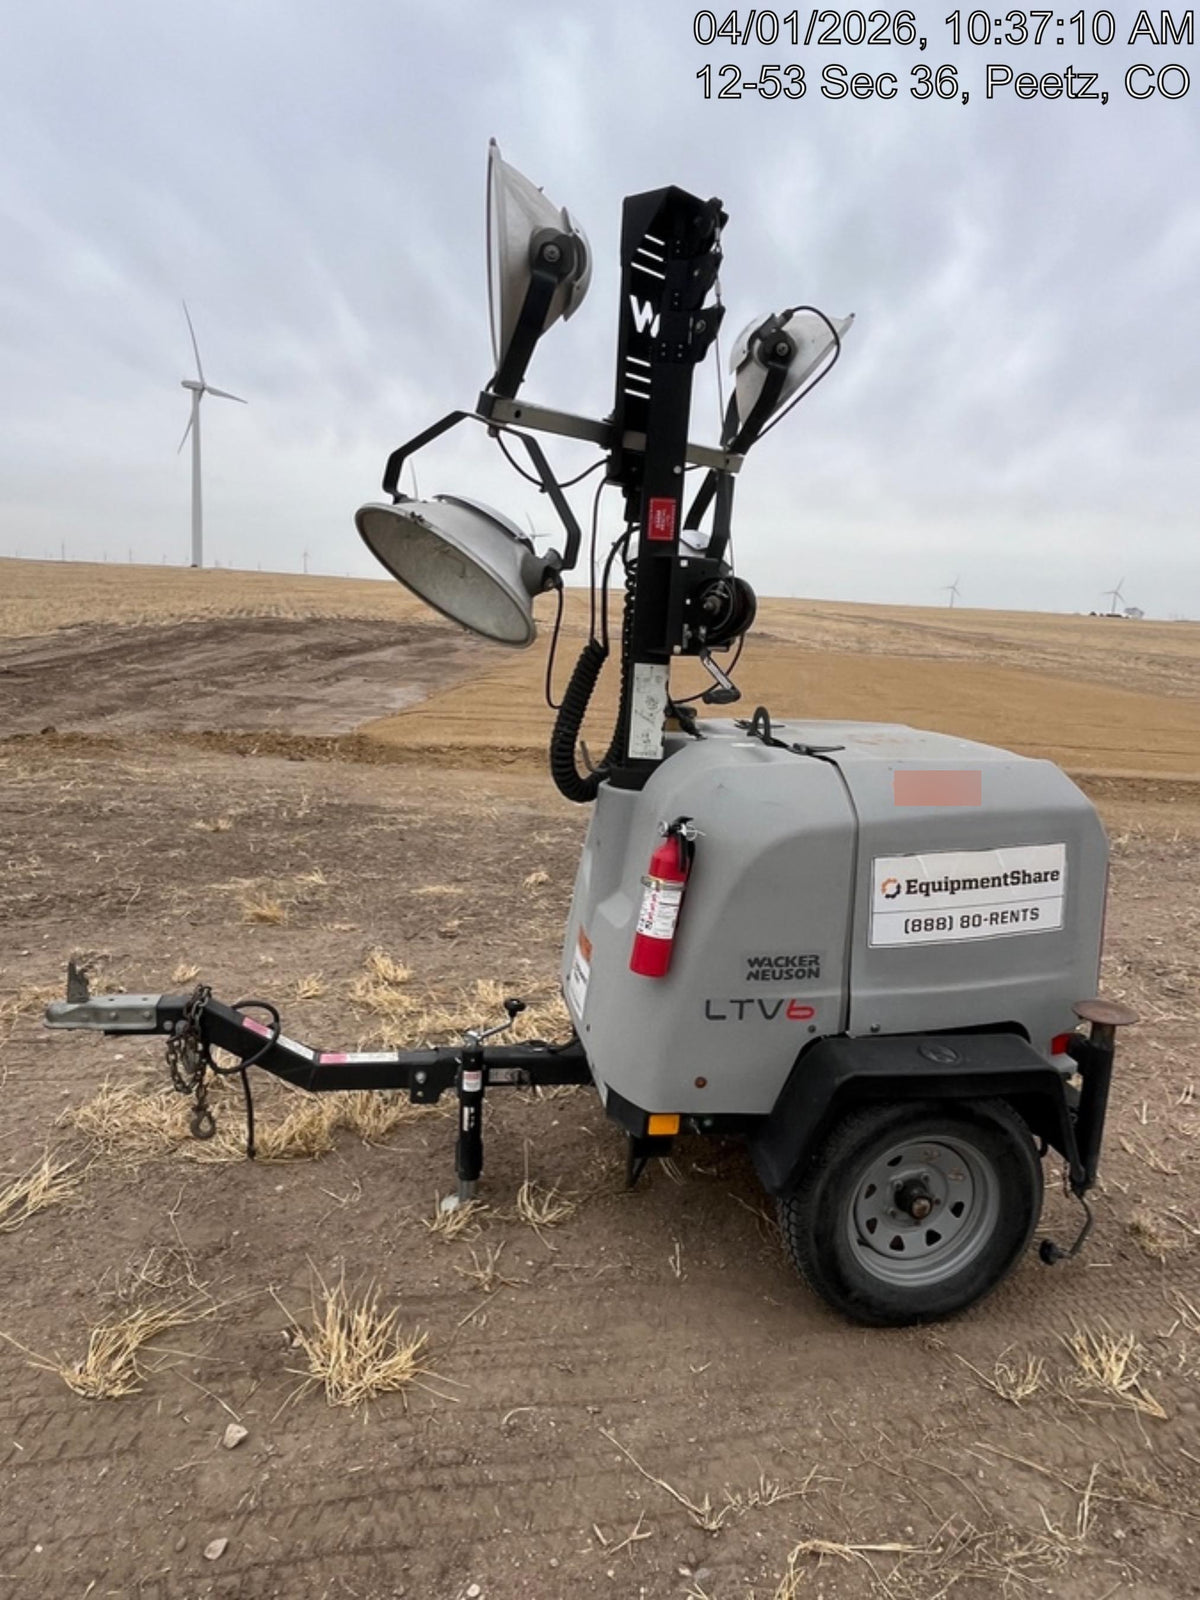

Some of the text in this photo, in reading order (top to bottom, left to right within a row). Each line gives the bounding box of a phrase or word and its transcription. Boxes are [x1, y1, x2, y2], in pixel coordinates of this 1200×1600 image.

[905, 869, 1060, 897] EquipmentShare
[904, 907, 1040, 934] (888) 80-RENTS
[746, 955, 821, 968] WACKER
[746, 967, 821, 981] NEUSON
[705, 998, 816, 1021] LTV6
